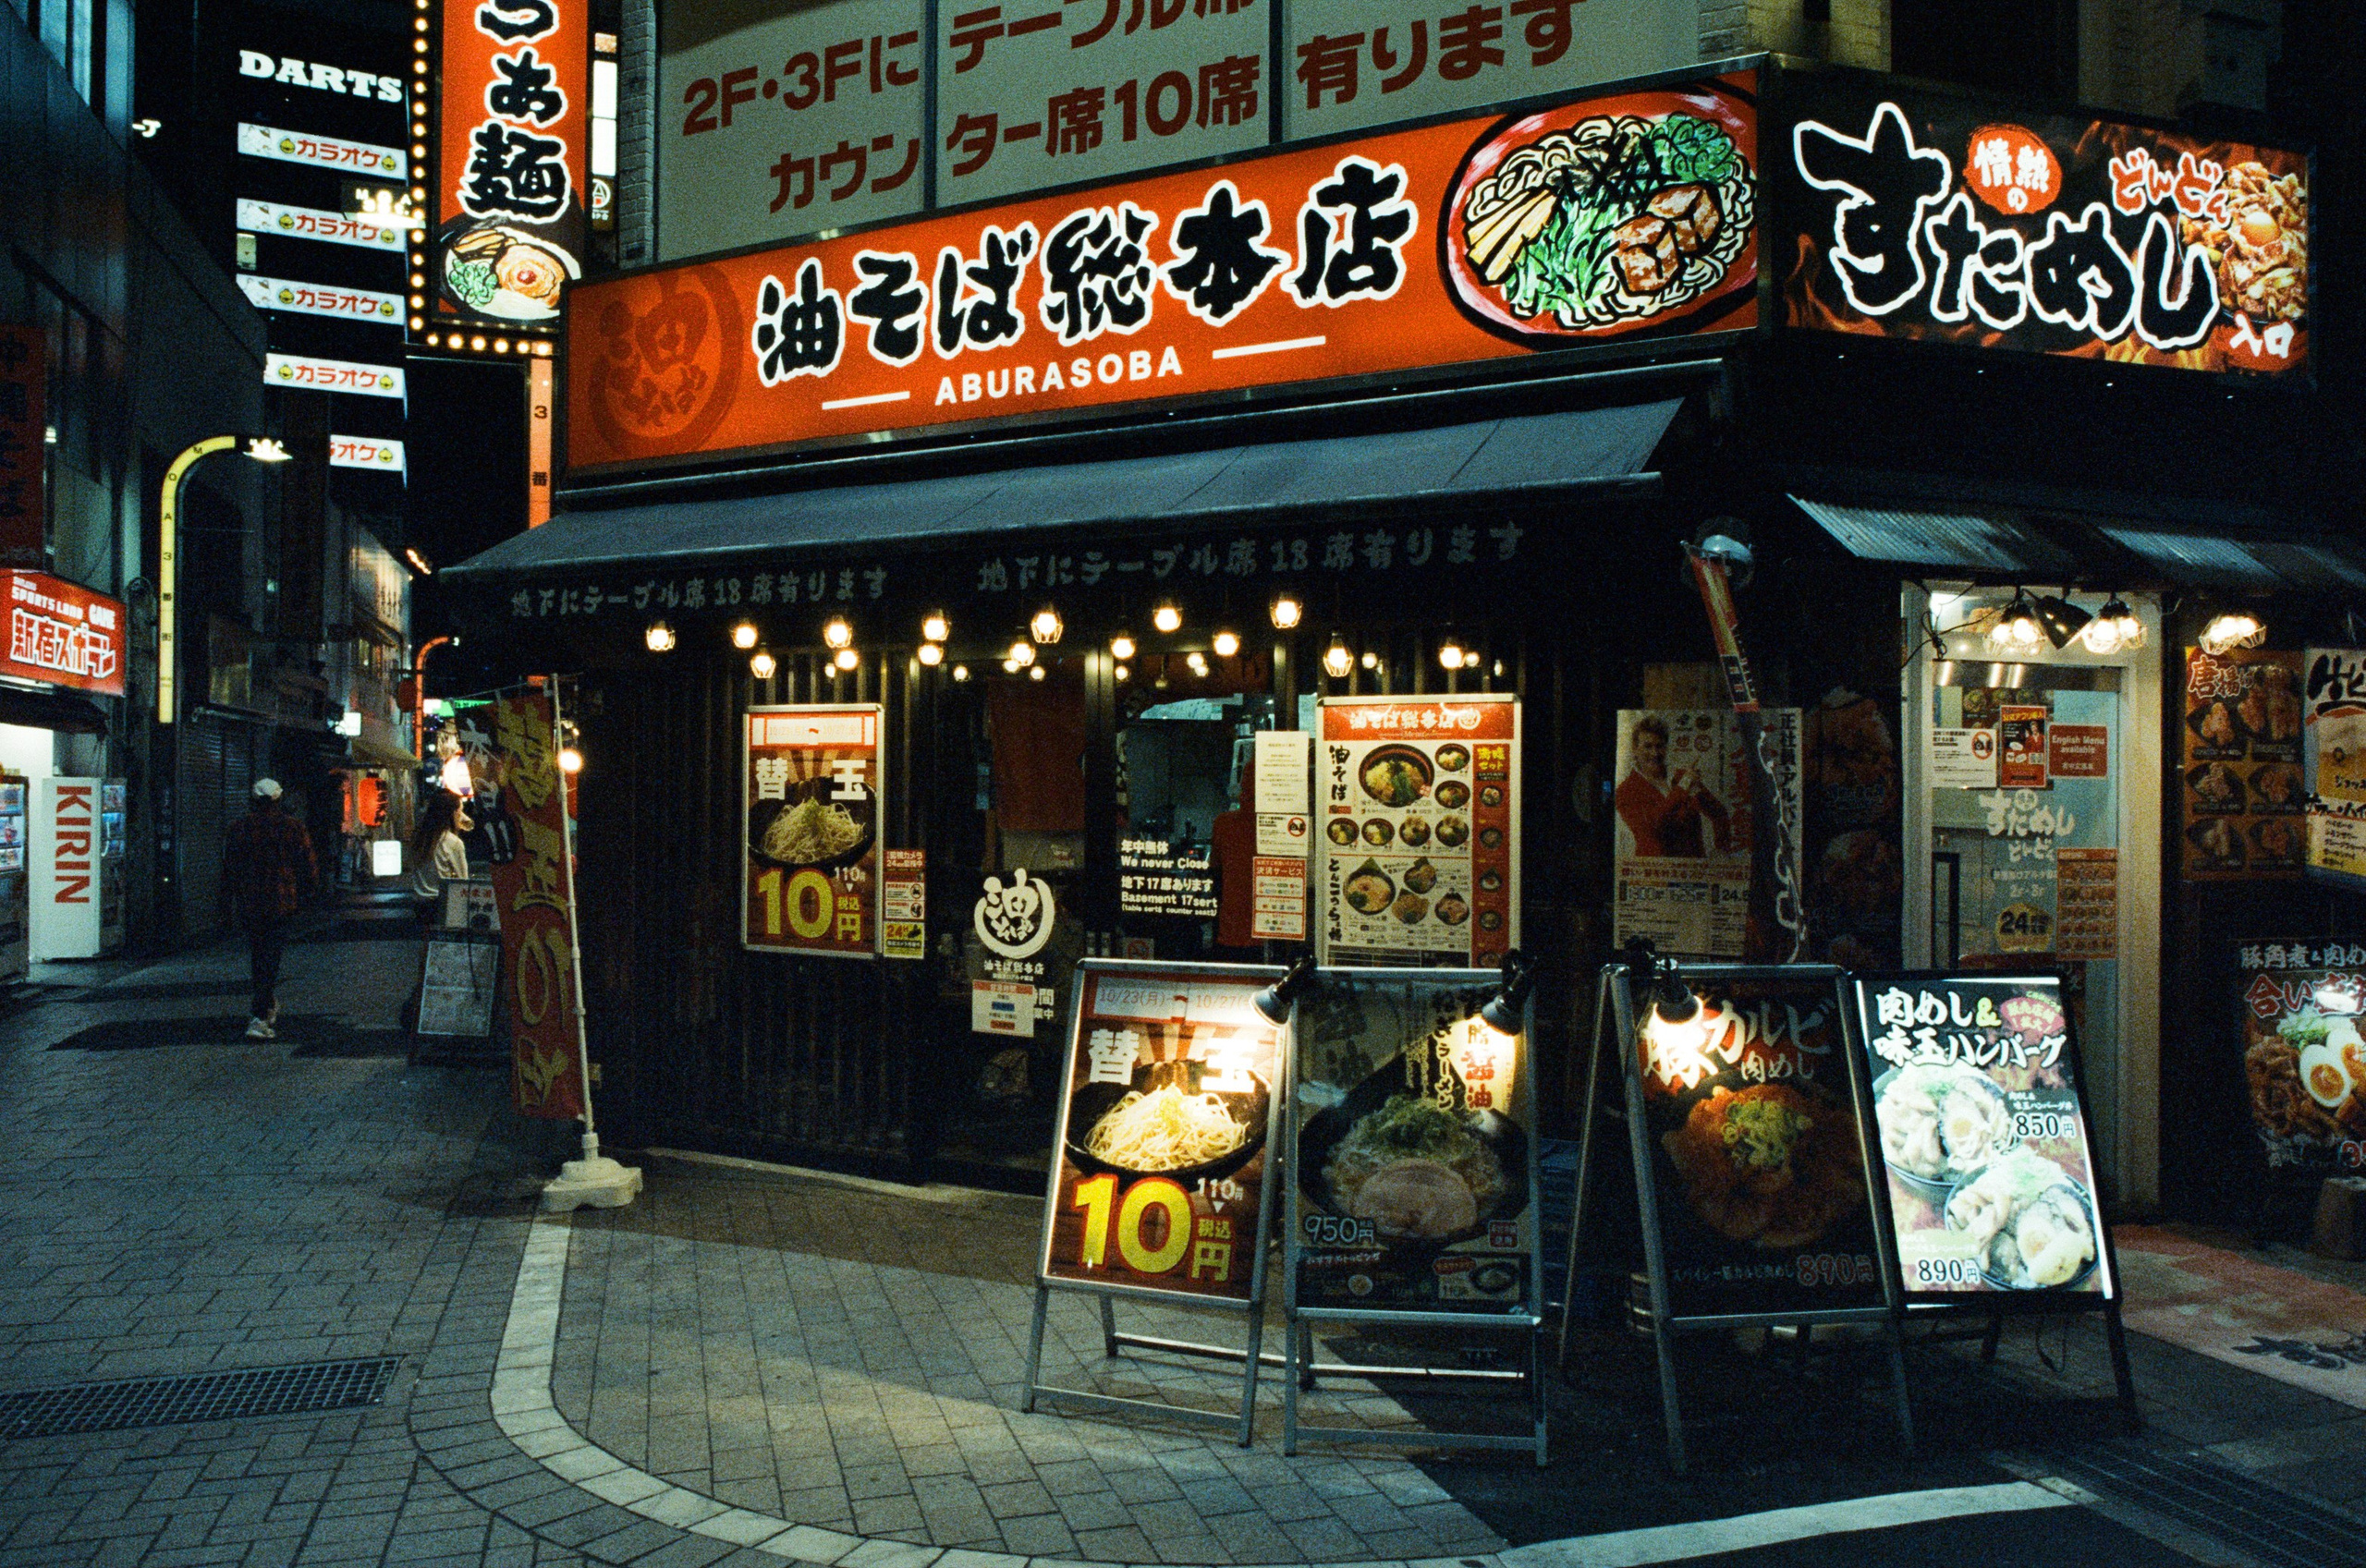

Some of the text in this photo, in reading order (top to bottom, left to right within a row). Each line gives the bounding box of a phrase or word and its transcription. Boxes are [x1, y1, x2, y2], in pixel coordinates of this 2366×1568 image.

[239, 49, 403, 103] DARTS
[297, 139, 381, 168] カラオケ
[2006, 187, 2028, 212] の
[296, 213, 380, 241] カラオケ
[752, 155, 1419, 388] 油そば総本店
[296, 288, 379, 315] カラオケ
[2229, 314, 2296, 359] 入口
[295, 364, 378, 388] カラオケ
[933, 346, 1183, 407] ABURASOBA
[330, 441, 378, 461] オケ
[12, 586, 55, 612] SPORTS
[755, 757, 867, 801] 替玉
[55, 785, 92, 904] KIRIN
[1121, 838, 1169, 855] 年中無休
[1120, 855, 1210, 869] We never Close
[1121, 875, 1213, 893] 地下17席あります
[1121, 891, 1177, 905] Basement
[755, 867, 834, 941] 10
[836, 912, 861, 942] 円
[1087, 1028, 1260, 1094] 替玉
[1872, 1025, 2068, 1070] 味玉ハンバーグ
[1196, 1176, 1245, 1202] 110円
[1070, 1172, 1195, 1277] 10
[1198, 1216, 1232, 1240] 税込
[1190, 1238, 1233, 1282] 円
